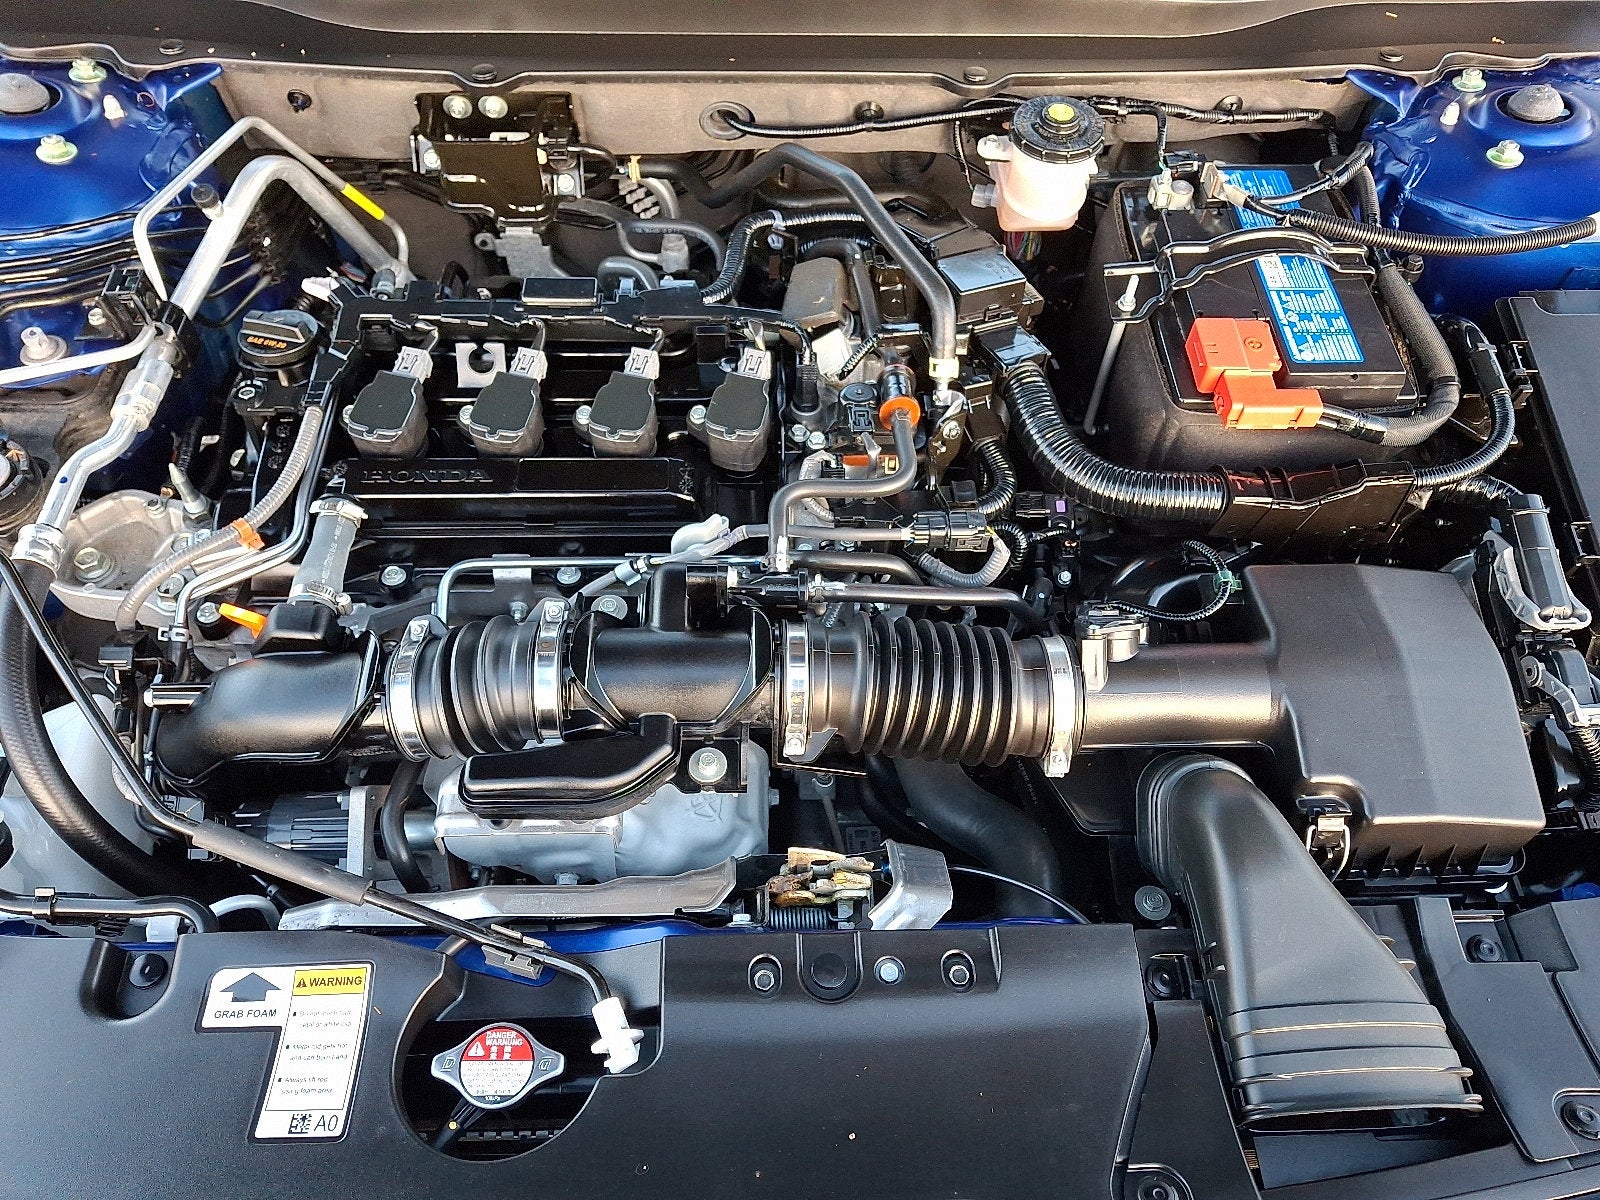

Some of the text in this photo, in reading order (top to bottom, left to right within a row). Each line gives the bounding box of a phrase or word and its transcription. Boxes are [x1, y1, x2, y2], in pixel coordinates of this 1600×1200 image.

[361, 469, 493, 483] HONDA
[309, 976, 363, 988] WARNING
[214, 1009, 277, 1019] GRAB FOAM
[485, 1031, 517, 1039] DANGER
[314, 1115, 339, 1132] A0
